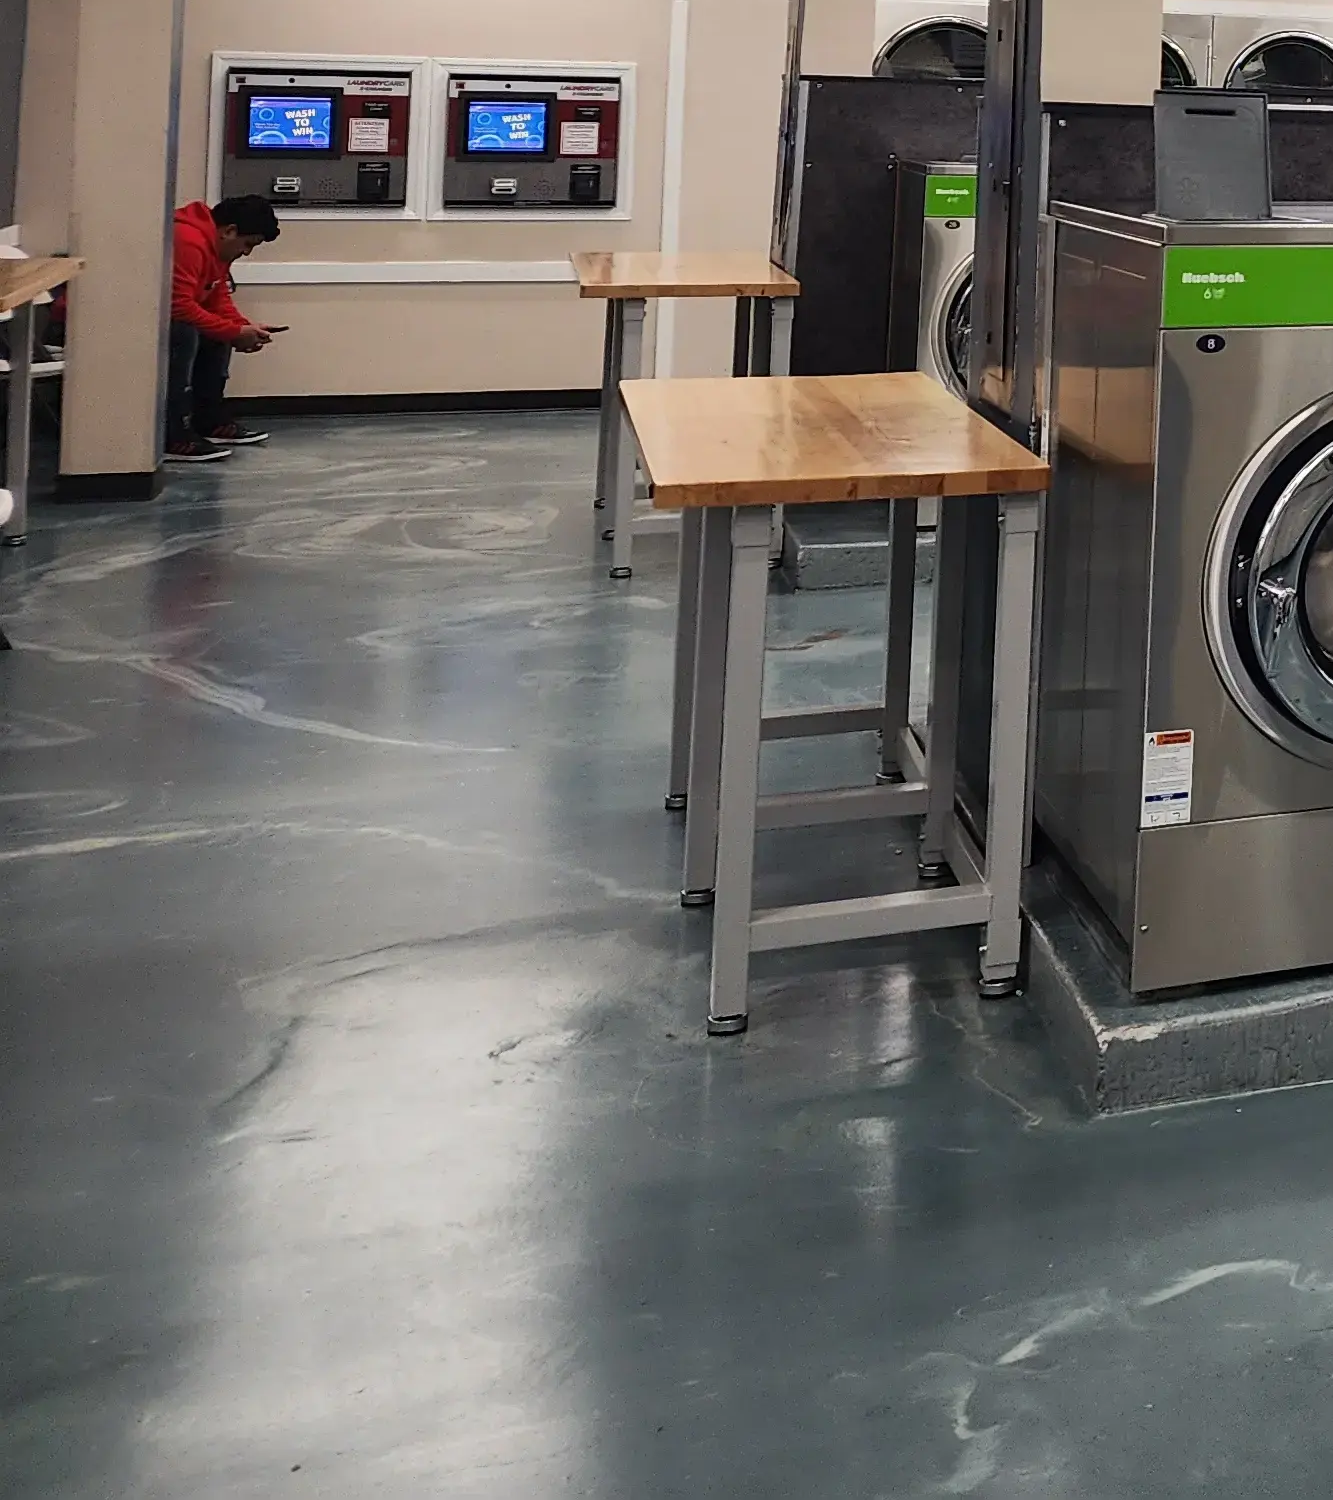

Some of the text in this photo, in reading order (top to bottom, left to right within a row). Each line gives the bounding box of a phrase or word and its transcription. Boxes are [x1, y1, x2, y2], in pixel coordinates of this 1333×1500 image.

[285, 109, 316, 120] WASH
[502, 113, 532, 123] WASH
[294, 119, 310, 127] TO
[510, 122, 526, 131] TO
[292, 127, 314, 137] WIN
[1182, 272, 1245, 284] Huebsch
[1207, 338, 1216, 349] 8
